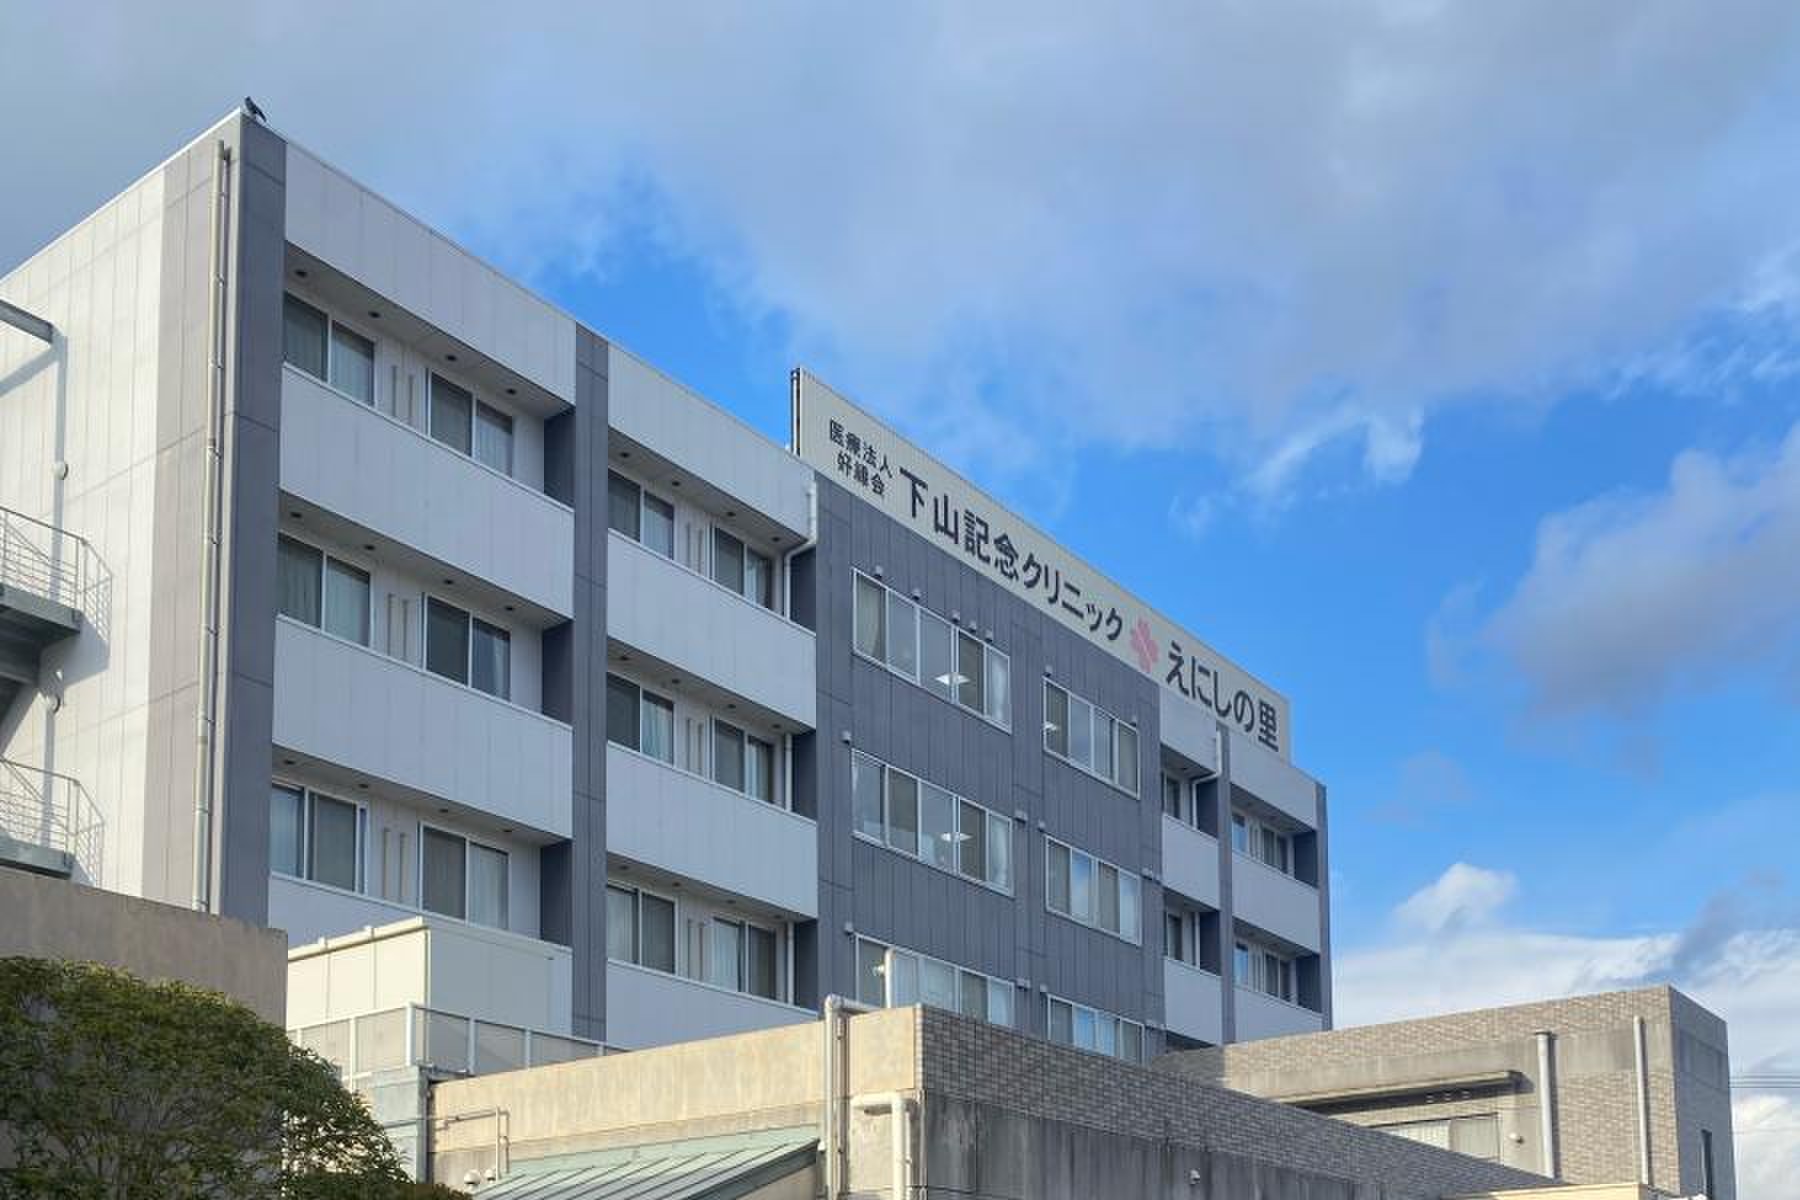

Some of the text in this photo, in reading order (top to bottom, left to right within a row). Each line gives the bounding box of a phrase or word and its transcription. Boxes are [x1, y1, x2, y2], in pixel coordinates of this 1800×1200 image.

[829, 419, 892, 478] 医療法人
[900, 466, 1279, 752] 下山記念クリニック えにしの里
